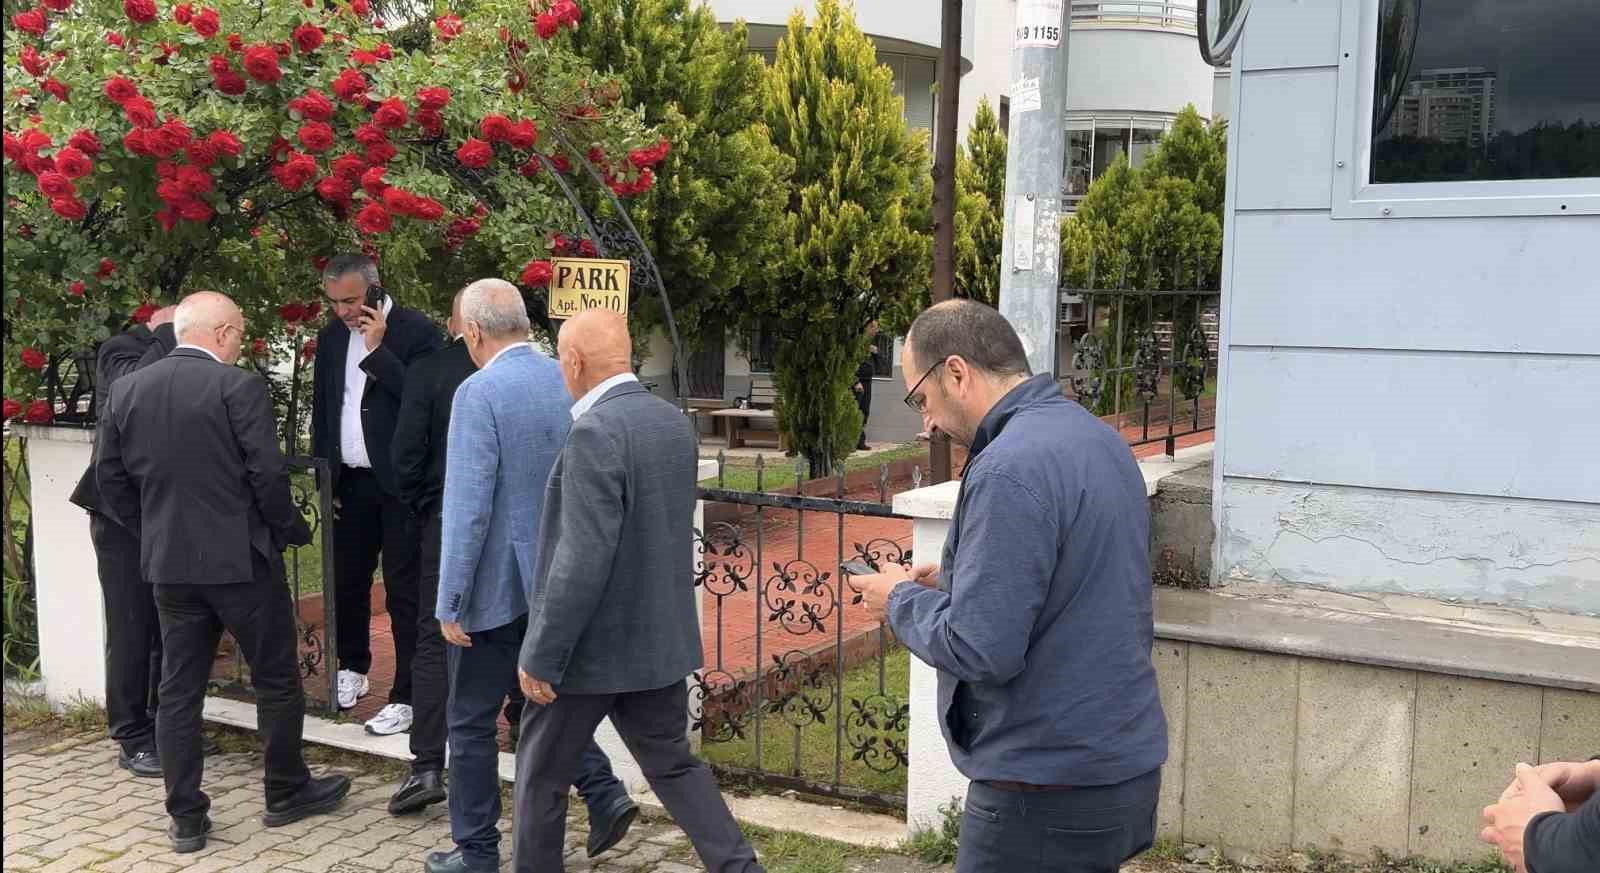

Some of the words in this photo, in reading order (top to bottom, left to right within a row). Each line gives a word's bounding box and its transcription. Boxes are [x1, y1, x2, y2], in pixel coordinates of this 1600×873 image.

[1033, 25, 1059, 41] 1155
[558, 266, 620, 291] PARK
[556, 299, 578, 313] Apt.
